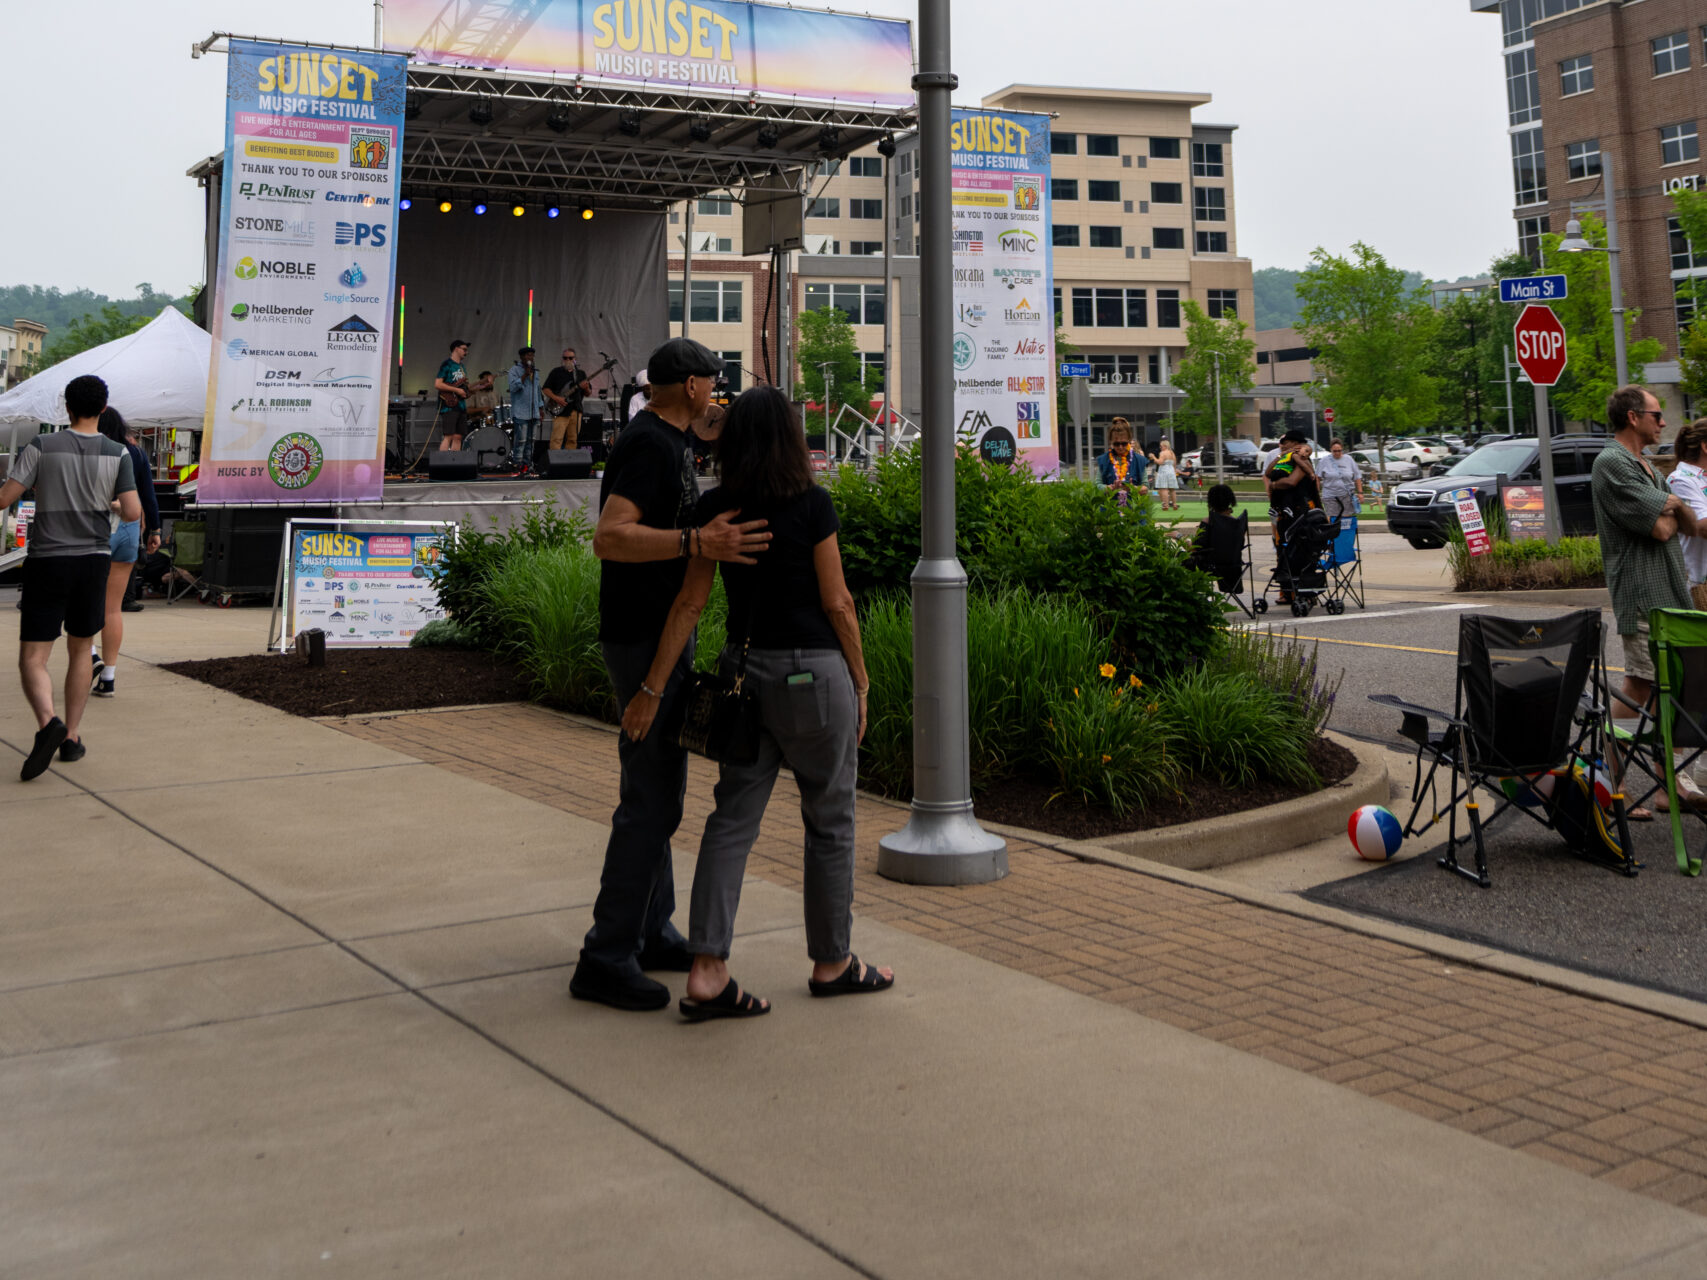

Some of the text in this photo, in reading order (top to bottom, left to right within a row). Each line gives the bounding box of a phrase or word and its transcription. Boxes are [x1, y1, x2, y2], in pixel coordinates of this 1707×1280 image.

[595, 52, 740, 85] MUSIC FESTIVAL
[258, 52, 379, 102] SUNSET
[258, 95, 376, 120] MUSIC FESTIVAL
[241, 116, 256, 124] LIVE
[258, 116, 280, 127] MUSIC
[288, 120, 345, 132] ENTERTAINMENT
[270, 128, 317, 139] FOR ALL AGES
[952, 116, 1030, 155] SUNSET
[250, 144, 335, 158] BENEFITING BEST BUDDIES
[952, 154, 1029, 169] MUSIC FESTIVAL
[241, 163, 388, 183] THANK YOU TO OUR SPONSORS
[1662, 174, 1700, 196] LOFT
[952, 210, 965, 218] ANK
[968, 211, 981, 219] YOU
[994, 212, 1008, 220] OUR
[1010, 213, 1039, 221] SPONSORS
[335, 222, 387, 247] DPS
[1002, 238, 1036, 252] MINC
[260, 261, 316, 275] NOBLE
[952, 269, 984, 281] oscana
[1510, 280, 1554, 298] Main St
[324, 293, 380, 304] SingleSource
[251, 304, 314, 316] hellbender
[1004, 309, 1040, 320] Horizon
[254, 316, 311, 324] MARKETING
[328, 332, 380, 343] LEGACY
[327, 343, 377, 352] Remodeling
[1014, 338, 1045, 355] Nate's
[1519, 330, 1562, 359] STOP
[265, 370, 302, 380] DSM
[1063, 365, 1069, 375] R
[959, 379, 1003, 387] hellbender
[1027, 376, 1045, 391] STAR
[1099, 372, 1152, 384] HOTEL
[960, 388, 1002, 396] MARKETING
[270, 398, 312, 407] ROBINSON
[985, 440, 1008, 449] DELTA
[991, 449, 1012, 458] WAVE
[218, 467, 264, 477] MUSIC BY
[278, 470, 308, 487] BAND
[1459, 502, 1474, 512] ROAD
[1460, 512, 1480, 522] CLOSED
[302, 533, 364, 556] SUNSET
[302, 557, 327, 565] MUSIC
[329, 557, 363, 566] FESTIVAL
[325, 582, 344, 590] DPS
